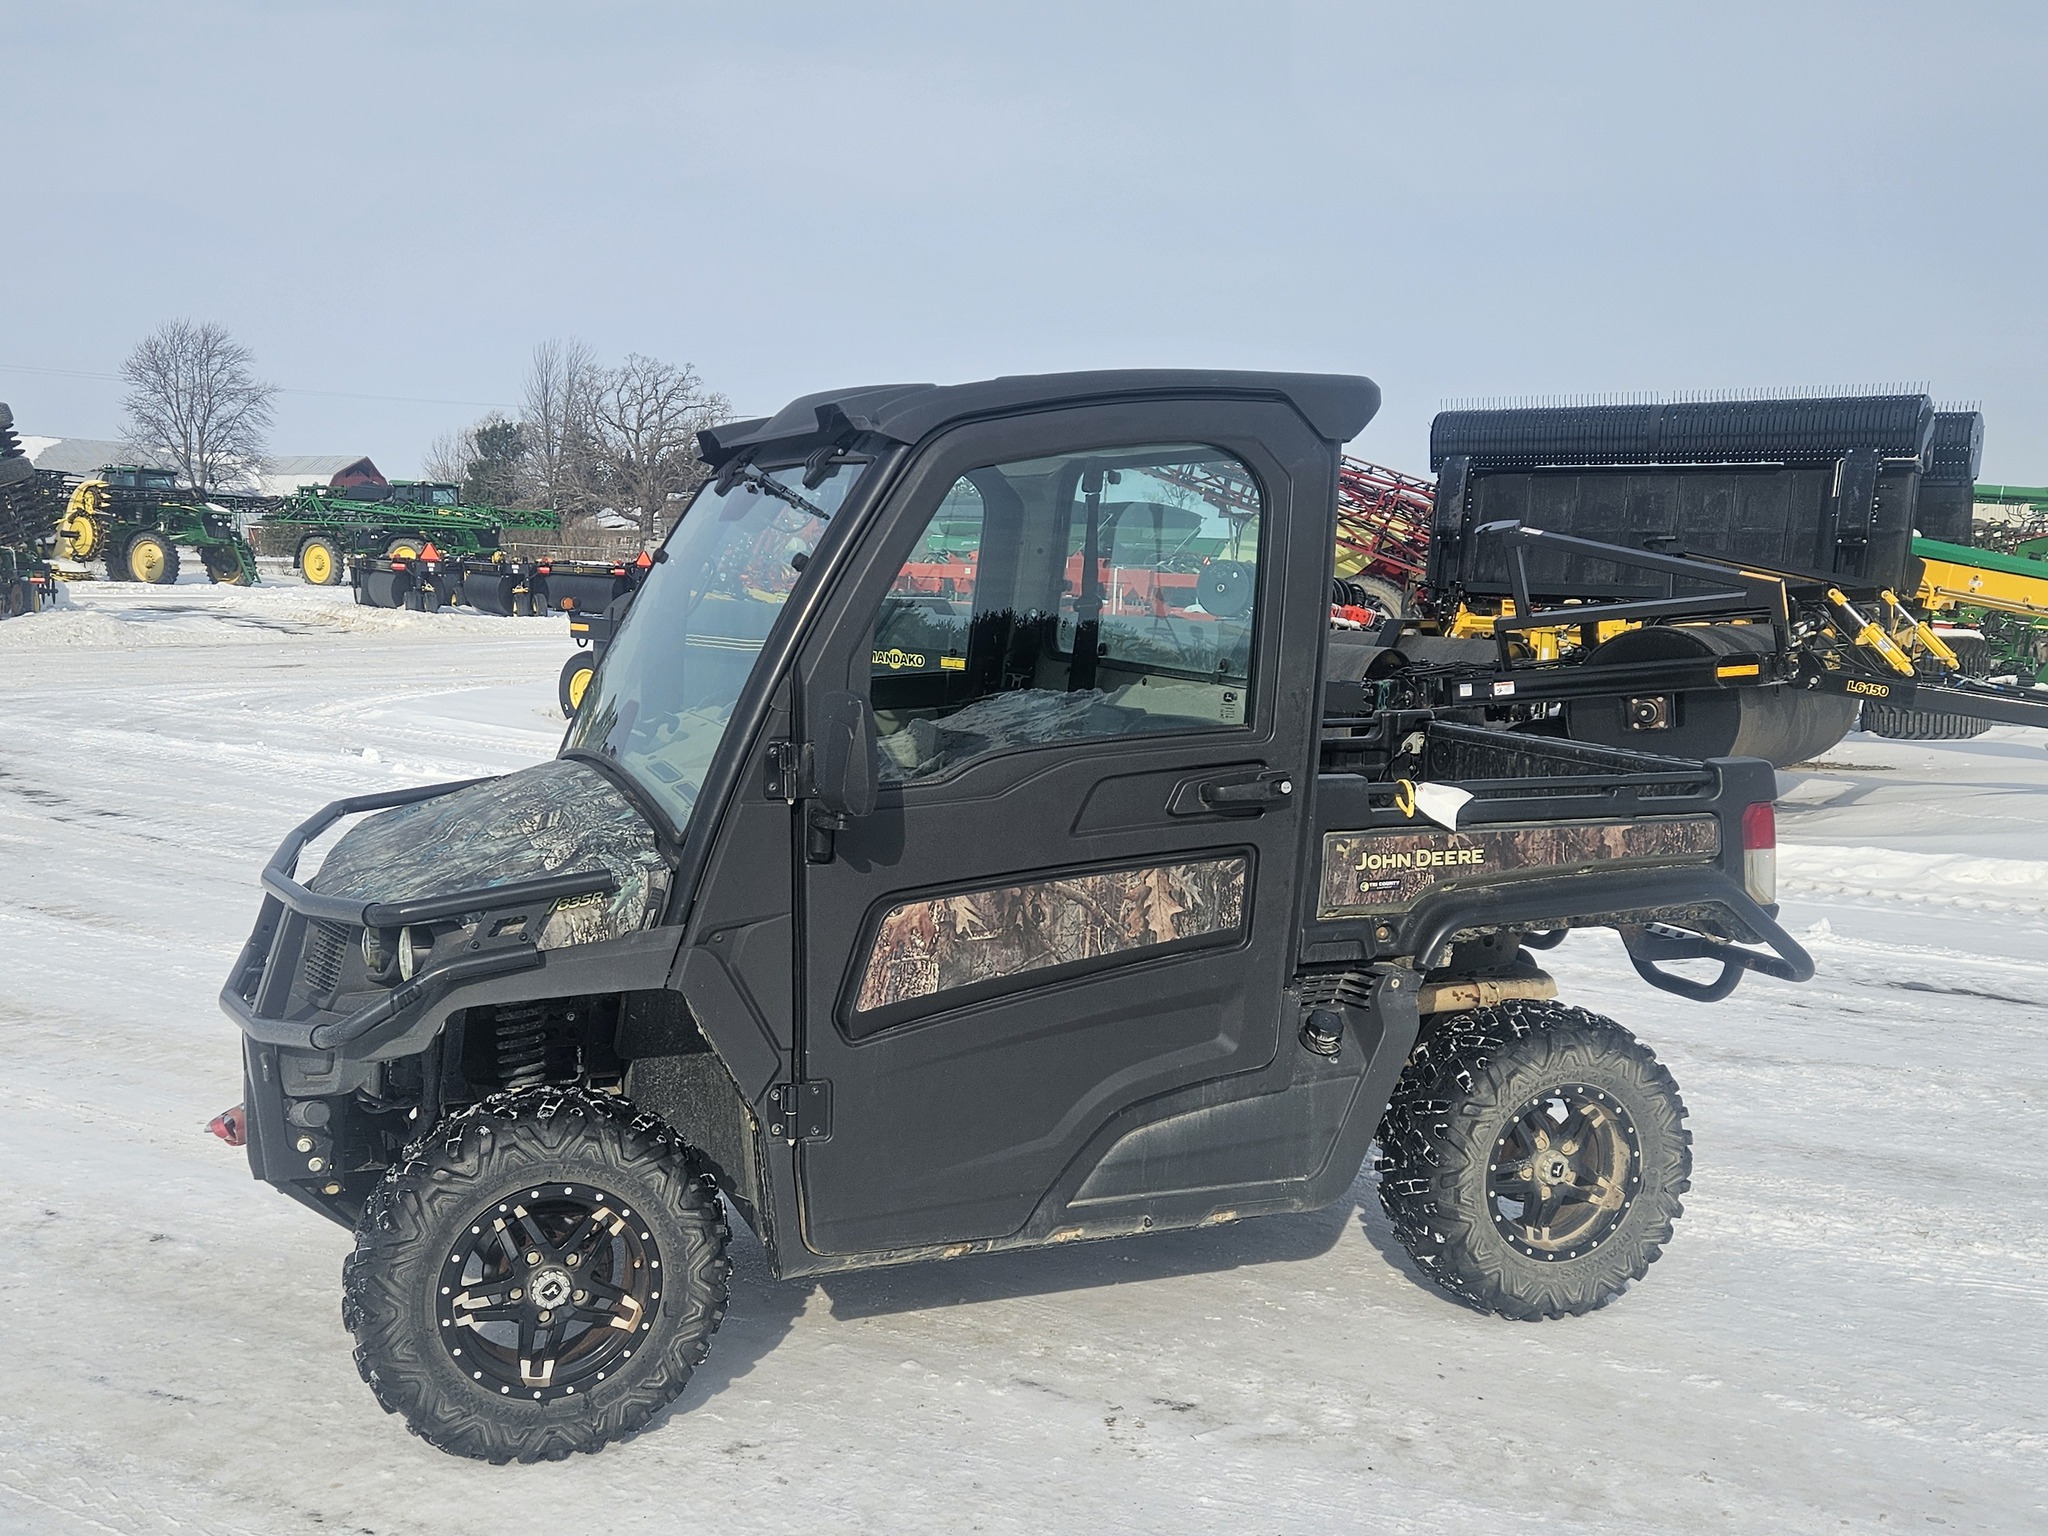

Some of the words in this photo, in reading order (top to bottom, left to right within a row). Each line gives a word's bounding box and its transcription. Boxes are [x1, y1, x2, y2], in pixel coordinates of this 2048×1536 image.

[1847, 680, 1890, 698] L6150
[1355, 851, 1412, 871] JOHN
[1415, 849, 1486, 868] DEERE
